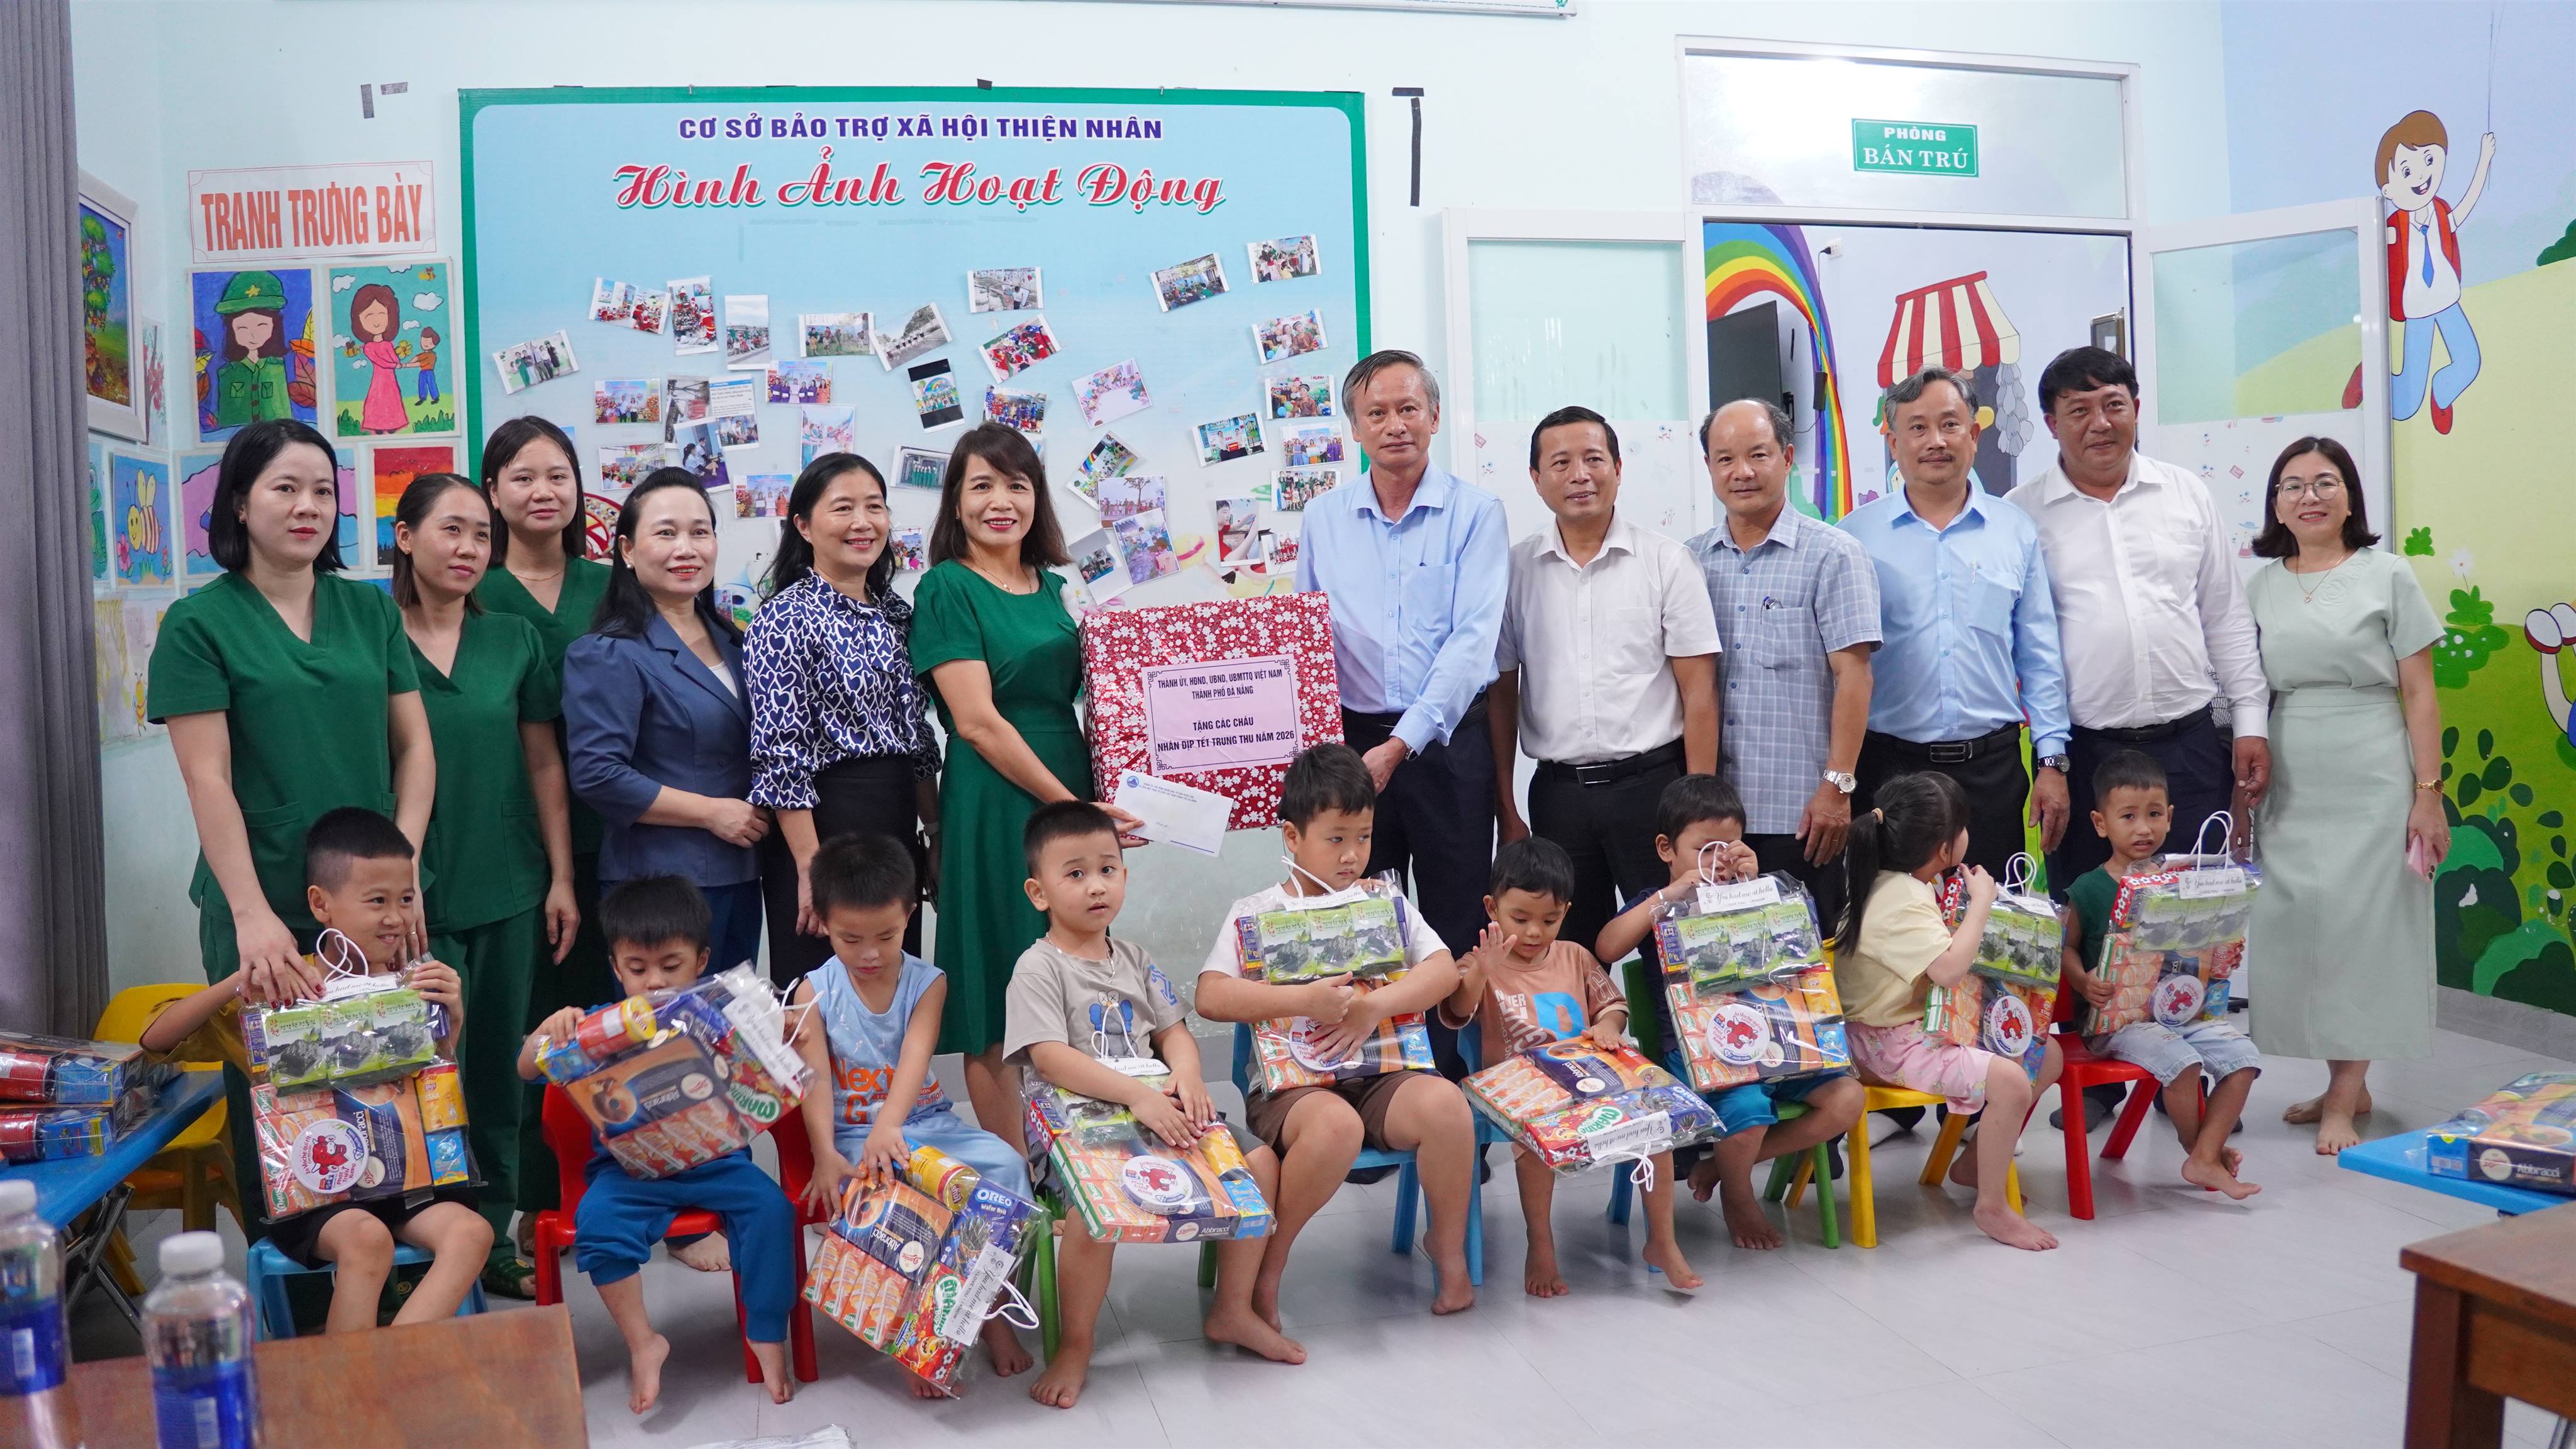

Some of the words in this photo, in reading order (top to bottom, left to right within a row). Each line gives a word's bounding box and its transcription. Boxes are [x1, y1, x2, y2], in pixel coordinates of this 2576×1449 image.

[680, 117, 717, 138] CƠ
[726, 113, 762, 138] SỞ
[771, 113, 827, 137] BẢO
[836, 116, 889, 141] TRỢ
[897, 114, 933, 136] XÃ
[942, 114, 988, 142] HỘI
[997, 115, 1077, 142] THIỆN
[1086, 116, 1162, 139] NHÂN
[1884, 126, 1946, 142] PHÒNG
[1863, 144, 1913, 165] BÁN
[1919, 147, 1968, 169] TRÚ
[614, 163, 765, 206] Hình
[777, 146, 903, 206] Ảnh
[921, 162, 1062, 210] Hoạt
[1077, 163, 1223, 211] Động
[201, 191, 282, 252] TRANH
[288, 181, 369, 247] TRƯNG
[375, 172, 422, 243] BÀY
[1158, 677, 1178, 689] THÀNH
[1179, 675, 1188, 687] ỦY,
[1190, 676, 1208, 686] HĐND,
[1209, 675, 1228, 684] UBND,
[1229, 672, 1253, 682] UBMTTQ
[1254, 669, 1267, 681] VIỆT
[1269, 669, 1282, 679] NAM
[1192, 688, 1212, 699] THÀNH
[1213, 685, 1226, 697] PHỐ
[1226, 686, 1236, 696] ĐÀ
[1236, 683, 1253, 696] NẴNG
[1193, 719, 1213, 732] TẶNG
[1216, 718, 1231, 729] CÁC
[1233, 716, 1253, 727] CHÁU
[1158, 740, 1179, 752] NHÂN
[1197, 736, 1209, 748] TẾT
[1211, 736, 1237, 747] TRUNG
[1239, 734, 1253, 744] THU
[1256, 731, 1274, 743] NĂM
[1276, 730, 1294, 740] 2026
[830, 1056, 896, 1092] Next
[976, 1189, 1013, 1207] OREO
[981, 1203, 996, 1211] Wafer
[996, 1207, 1007, 1215] Roll
[871, 1228, 901, 1251] Abbracci
[1201, 1225, 1230, 1235] Abbracci
[976, 1285, 987, 1301] had
[956, 1316, 970, 1336] hello
